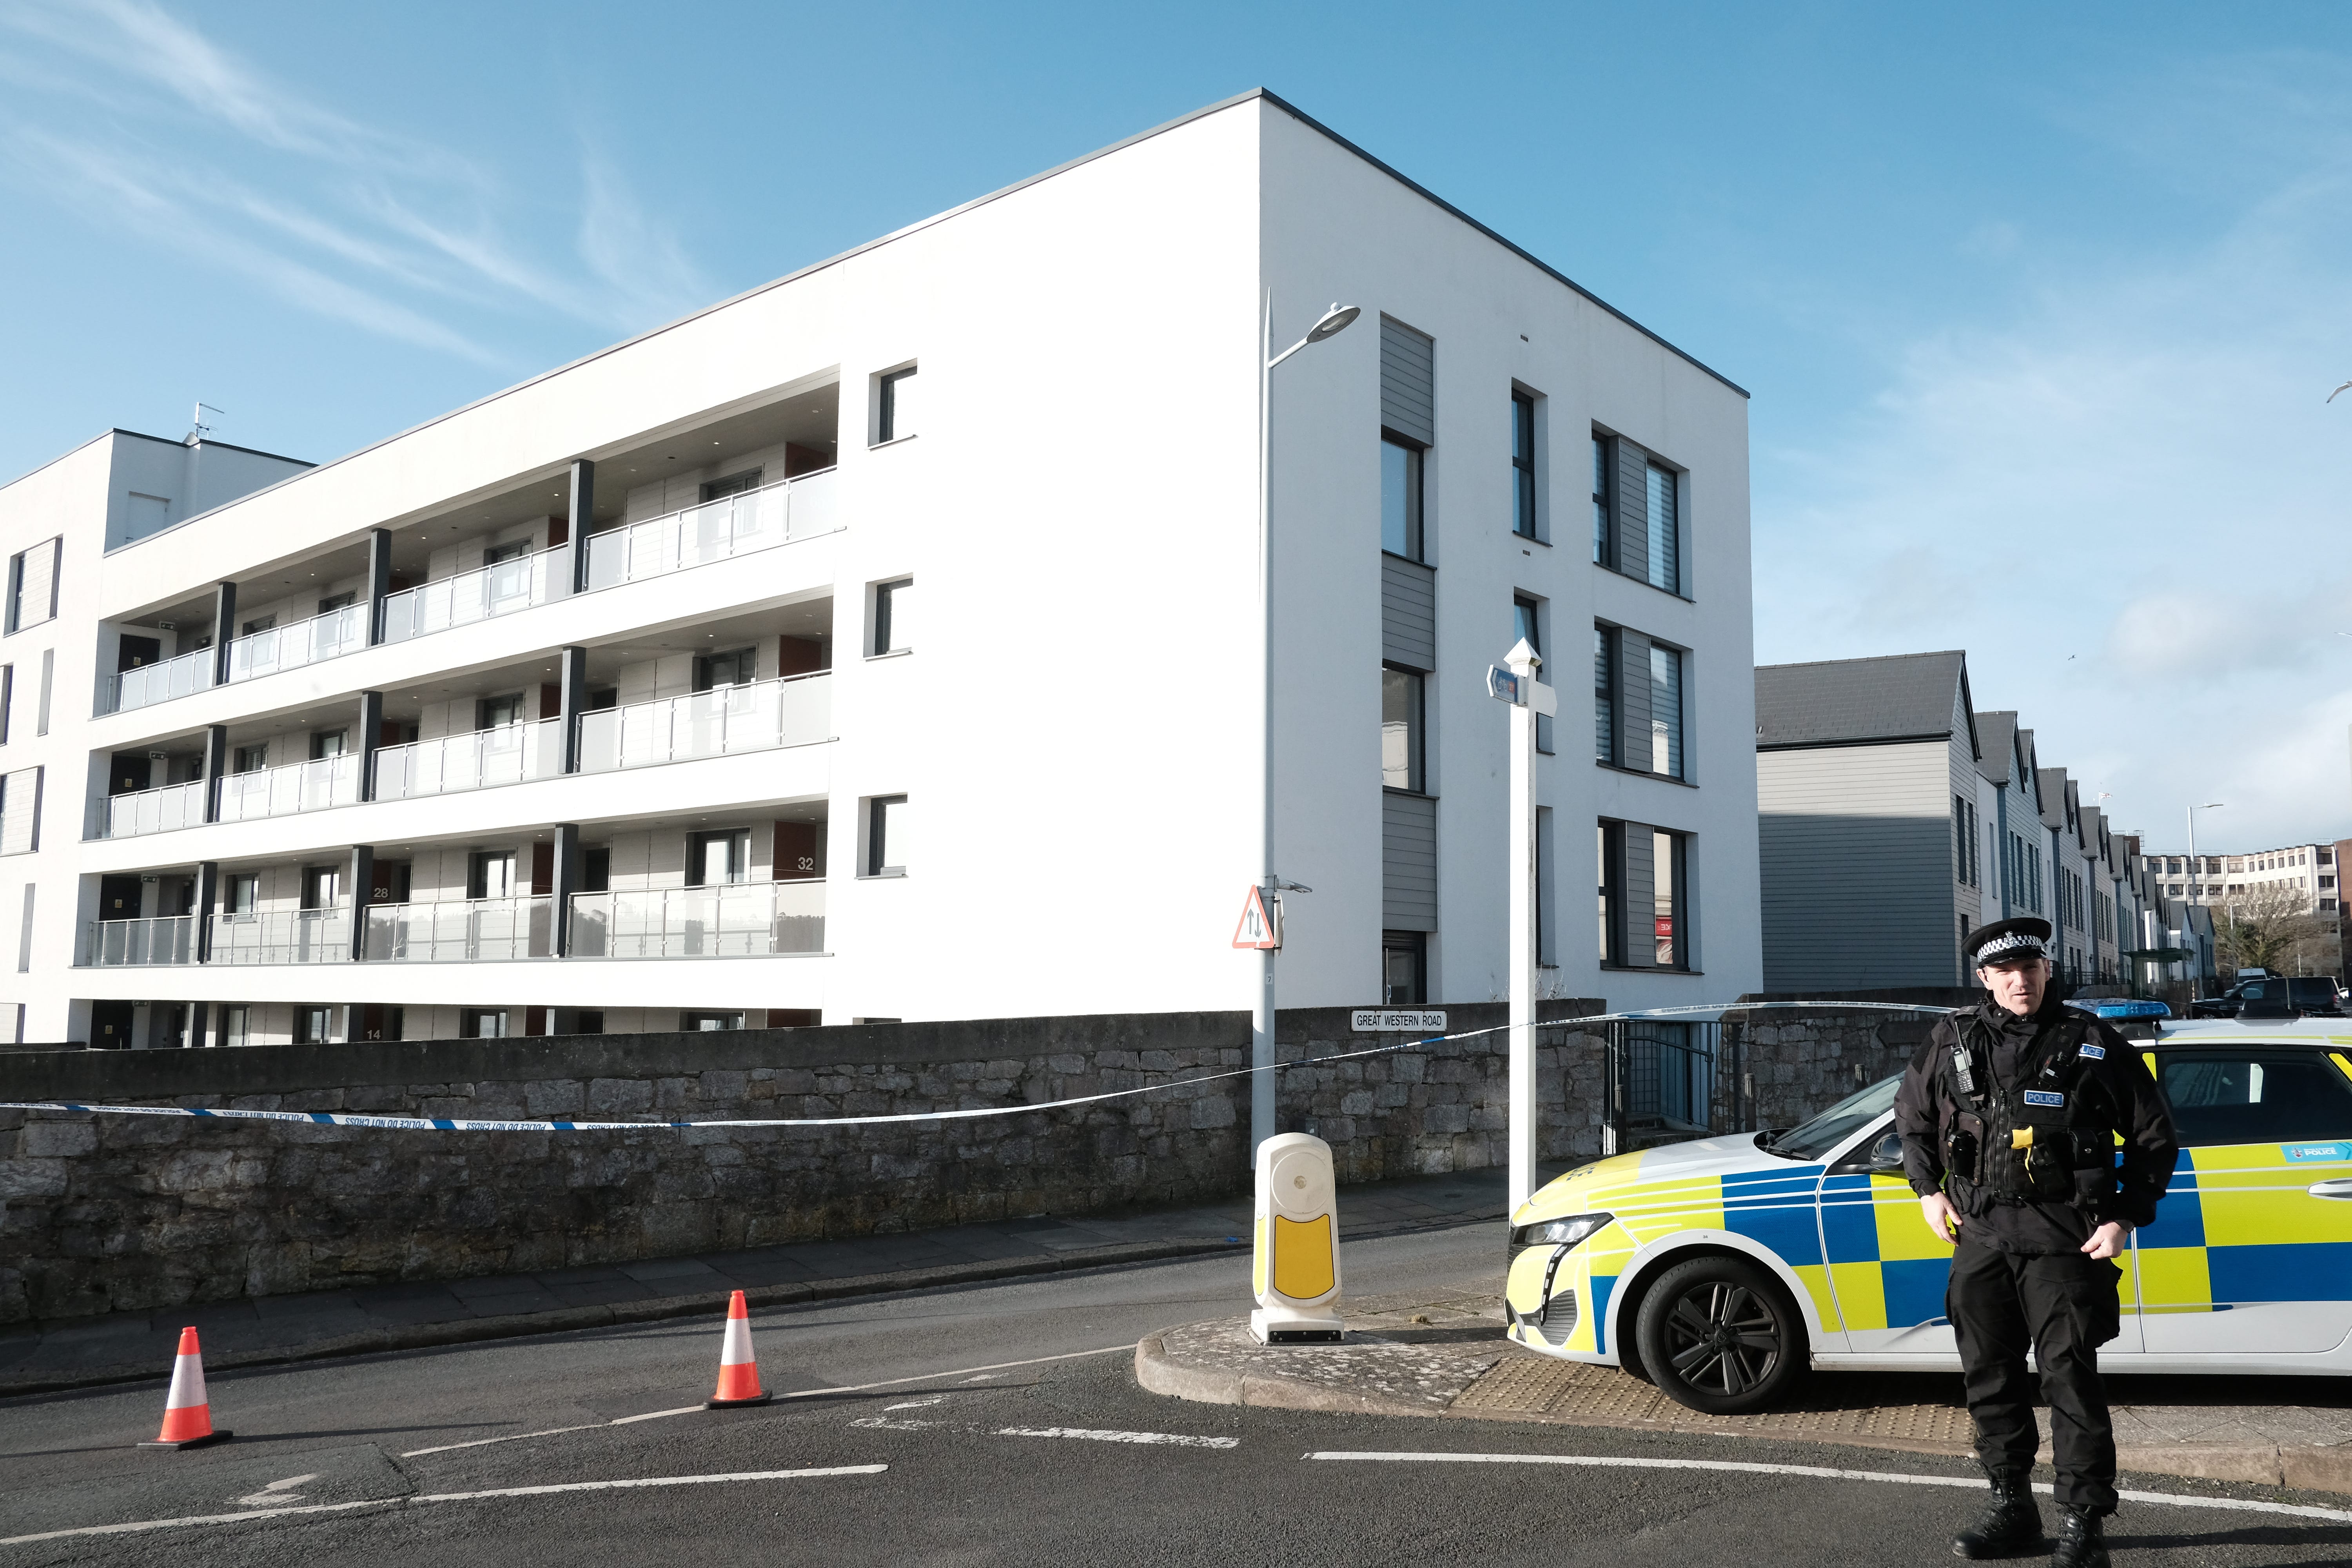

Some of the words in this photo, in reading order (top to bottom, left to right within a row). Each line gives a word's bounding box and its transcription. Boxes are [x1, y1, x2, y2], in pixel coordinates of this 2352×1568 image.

[798, 857, 813, 870] 32
[374, 887, 388, 898] 28
[1357, 1014, 1381, 1026] GREAT
[1385, 1014, 1419, 1026] WESTERN
[1423, 1015, 1442, 1026] ROAD
[367, 1029, 381, 1040] 14
[2080, 1046, 2101, 1056] LICE
[2028, 1093, 2060, 1104] POLICE
[278, 1113, 304, 1122] POLICE
[345, 1117, 370, 1127] CROSS
[371, 1118, 386, 1127] NOT
[387, 1119, 398, 1128] DO
[399, 1120, 426, 1129] POLICE
